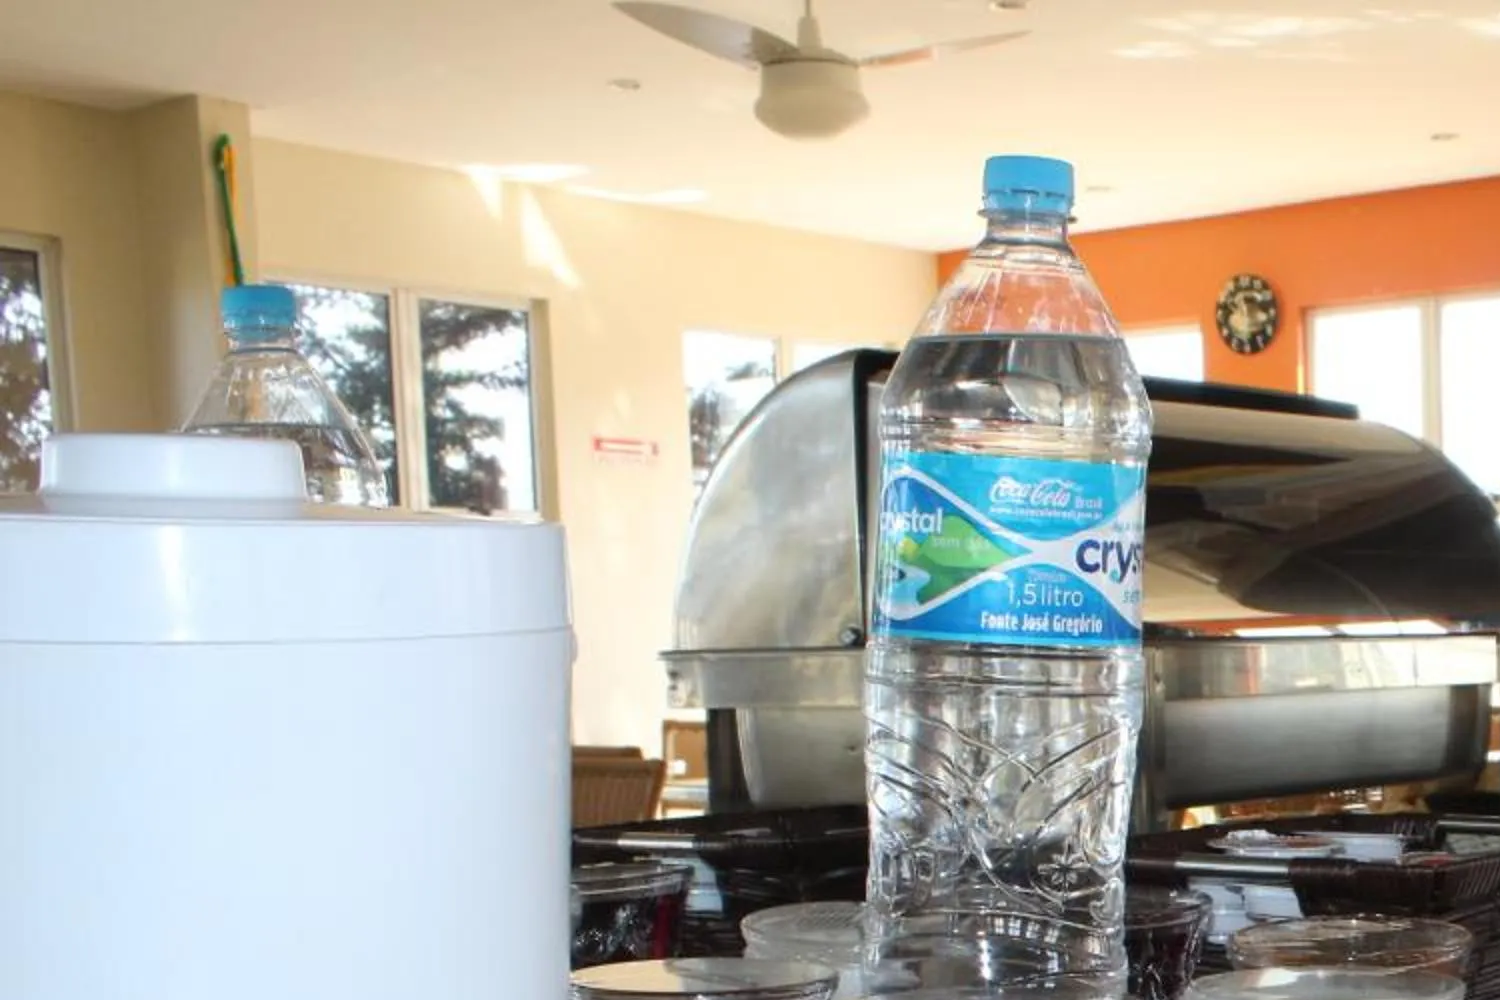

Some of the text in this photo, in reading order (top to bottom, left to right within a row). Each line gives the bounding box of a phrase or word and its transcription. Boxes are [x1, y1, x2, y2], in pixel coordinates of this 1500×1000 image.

[1007, 582, 1085, 608] 1,5 litro
[980, 610, 1103, 637] Fonte José Gregório
